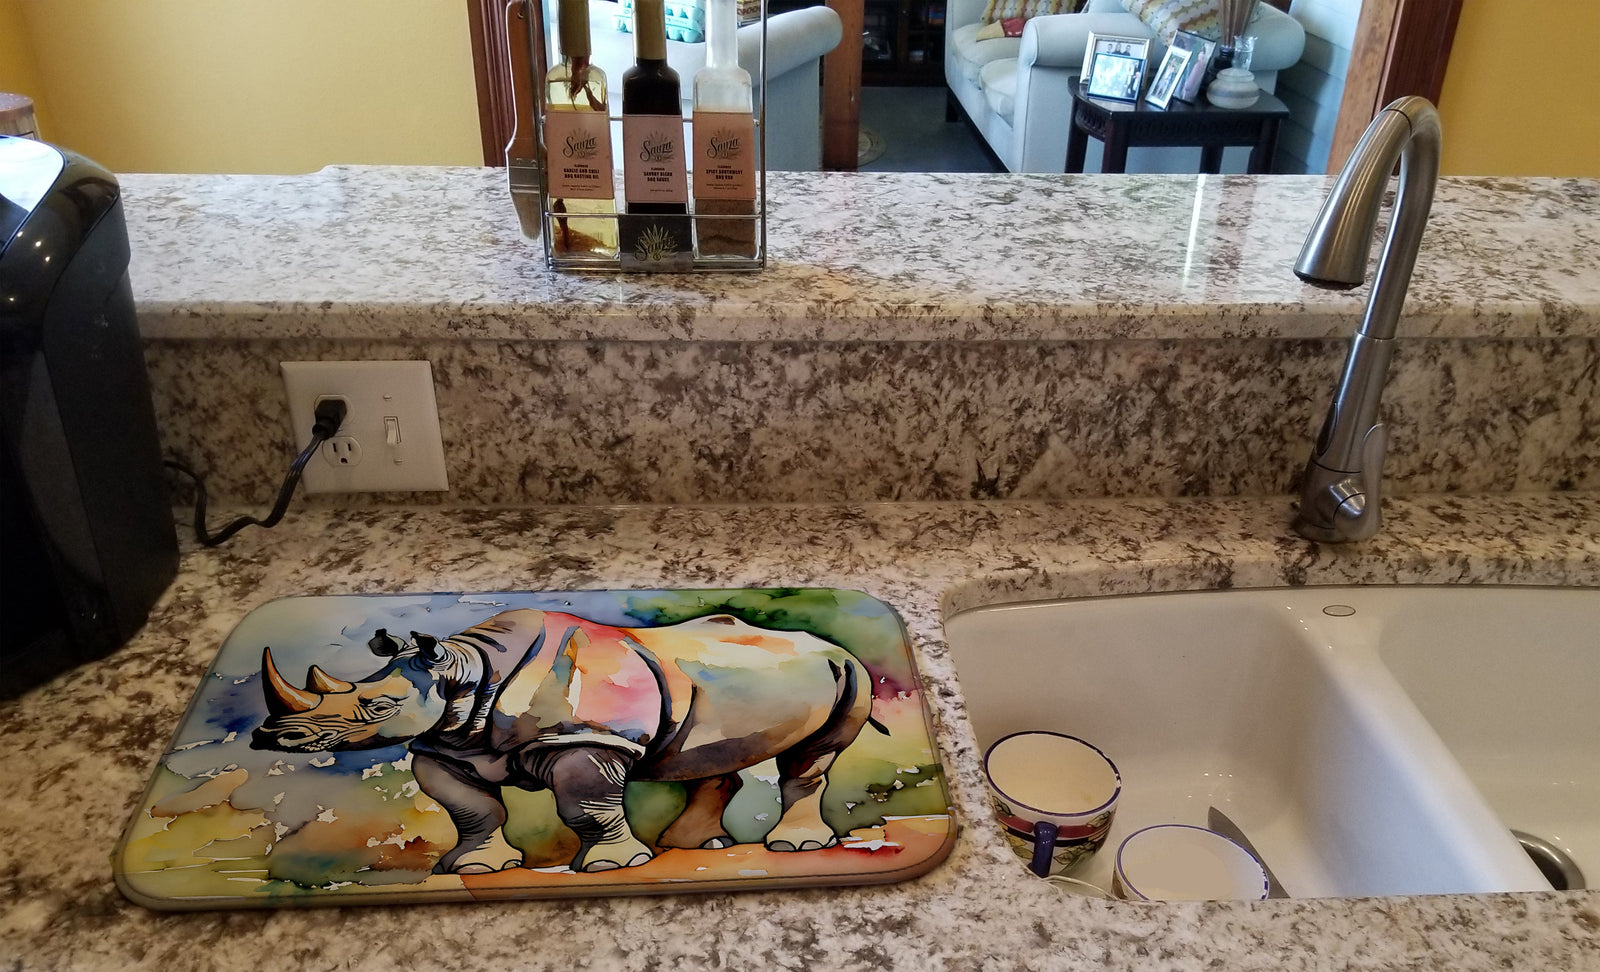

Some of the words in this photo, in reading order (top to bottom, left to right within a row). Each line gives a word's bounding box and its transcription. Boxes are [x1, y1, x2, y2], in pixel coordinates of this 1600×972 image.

[562, 136, 598, 158] Sauza
[640, 140, 674, 162] Sauza
[707, 136, 741, 159] Sauza
